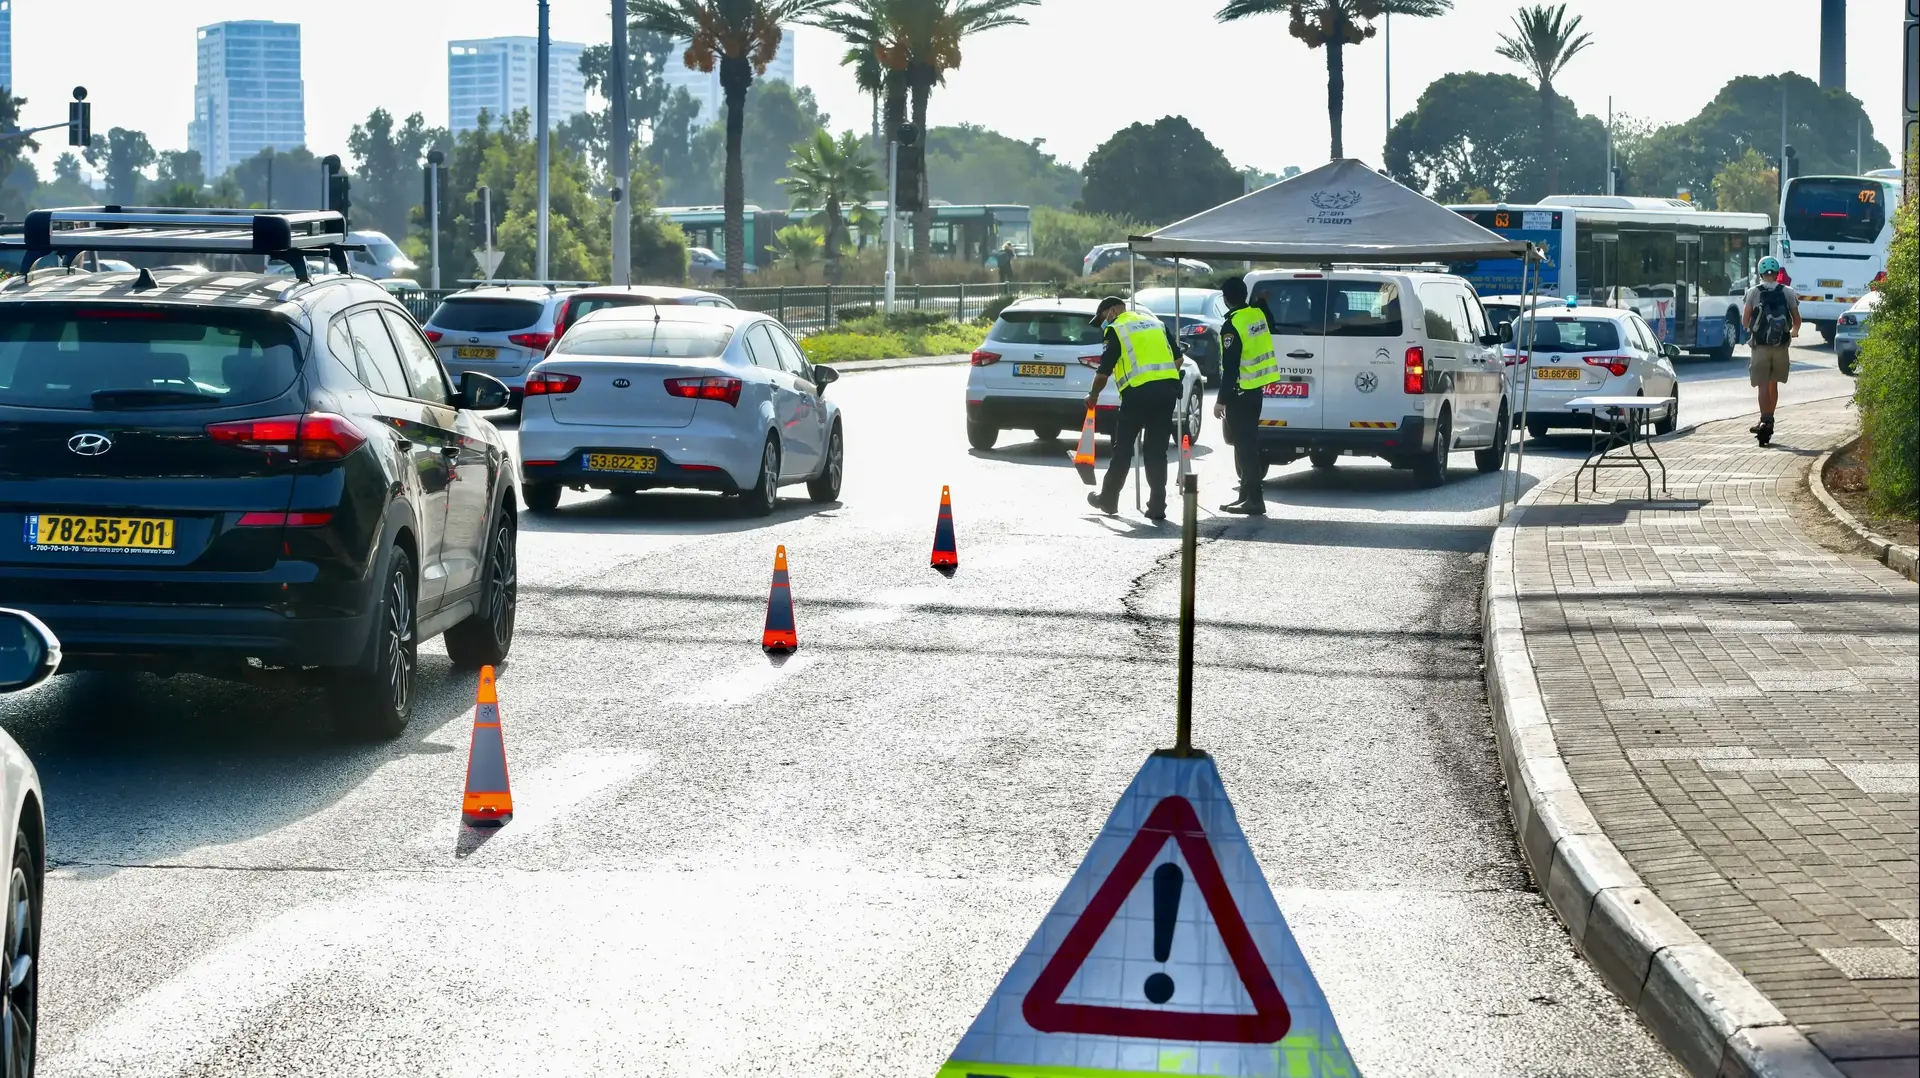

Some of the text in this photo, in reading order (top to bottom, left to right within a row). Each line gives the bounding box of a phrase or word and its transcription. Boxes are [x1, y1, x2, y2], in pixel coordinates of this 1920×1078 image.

[1858, 190, 1876, 204] 472
[1306, 216, 1353, 225] משטרה
[1495, 212, 1510, 228] 63
[30, 544, 79, 552] 1-700-70-10-70
